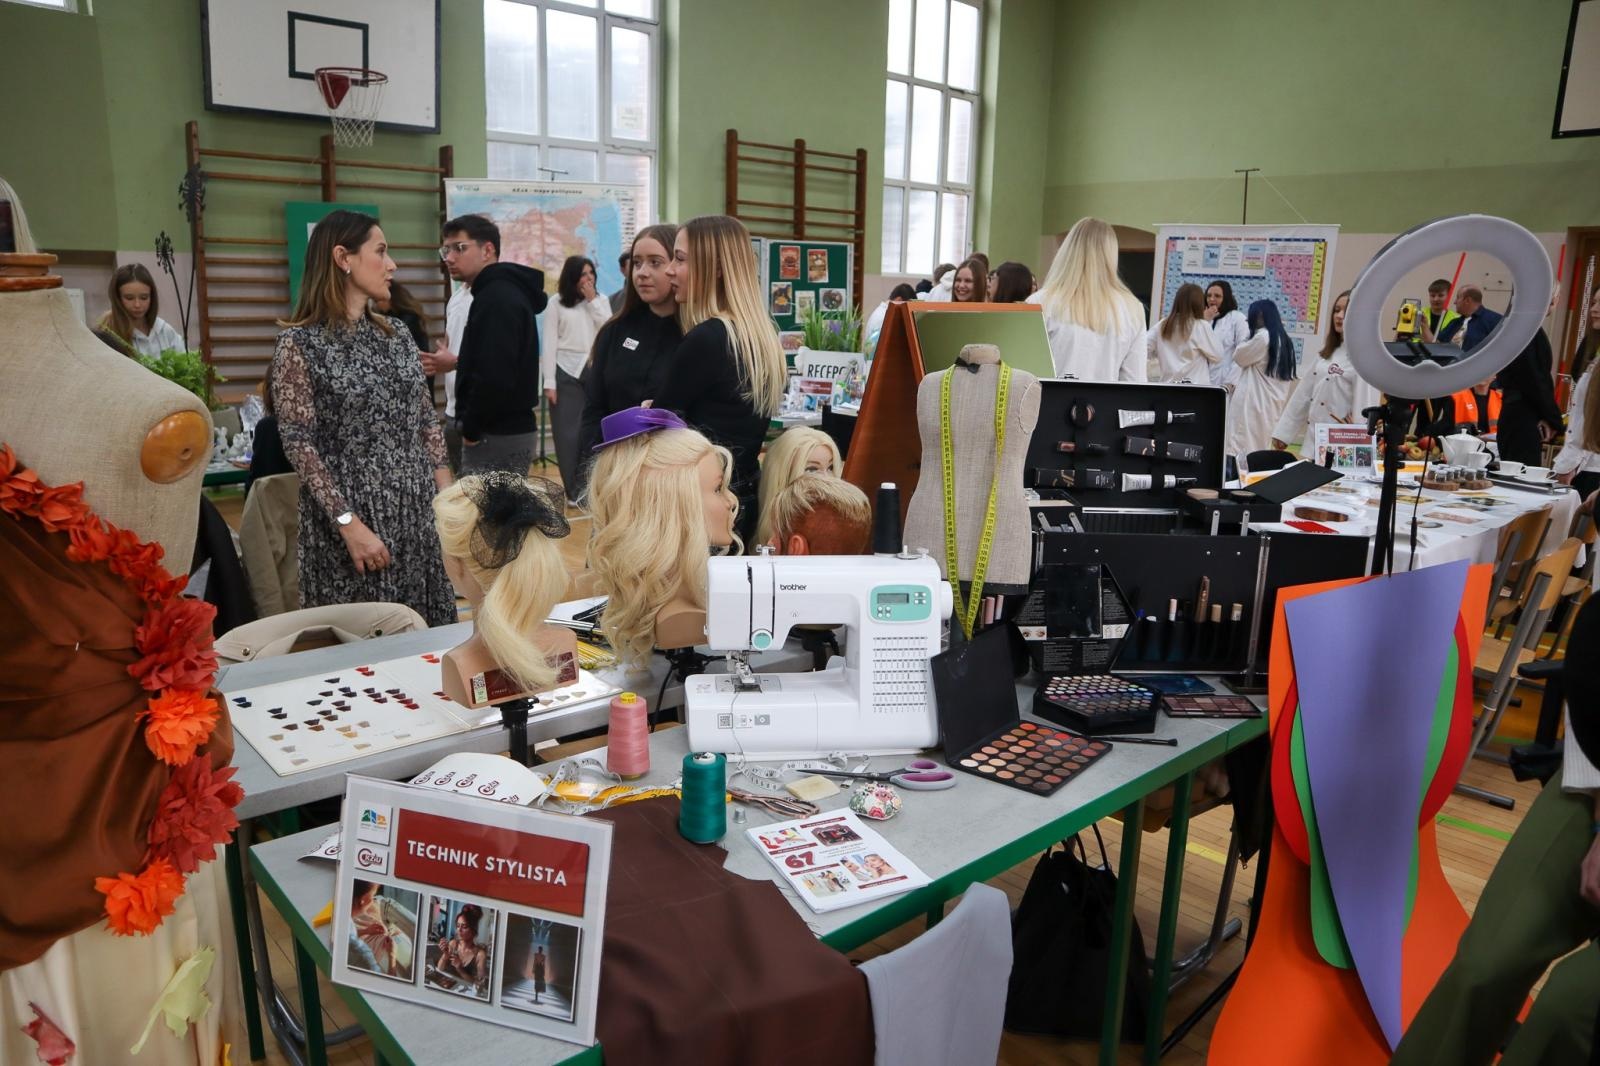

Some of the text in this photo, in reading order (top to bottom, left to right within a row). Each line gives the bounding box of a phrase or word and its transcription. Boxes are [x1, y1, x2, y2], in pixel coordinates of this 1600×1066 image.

[780, 583, 807, 591] brother
[407, 839, 567, 886] TECHNIK STYLISTA
[784, 851, 816, 869] 67
